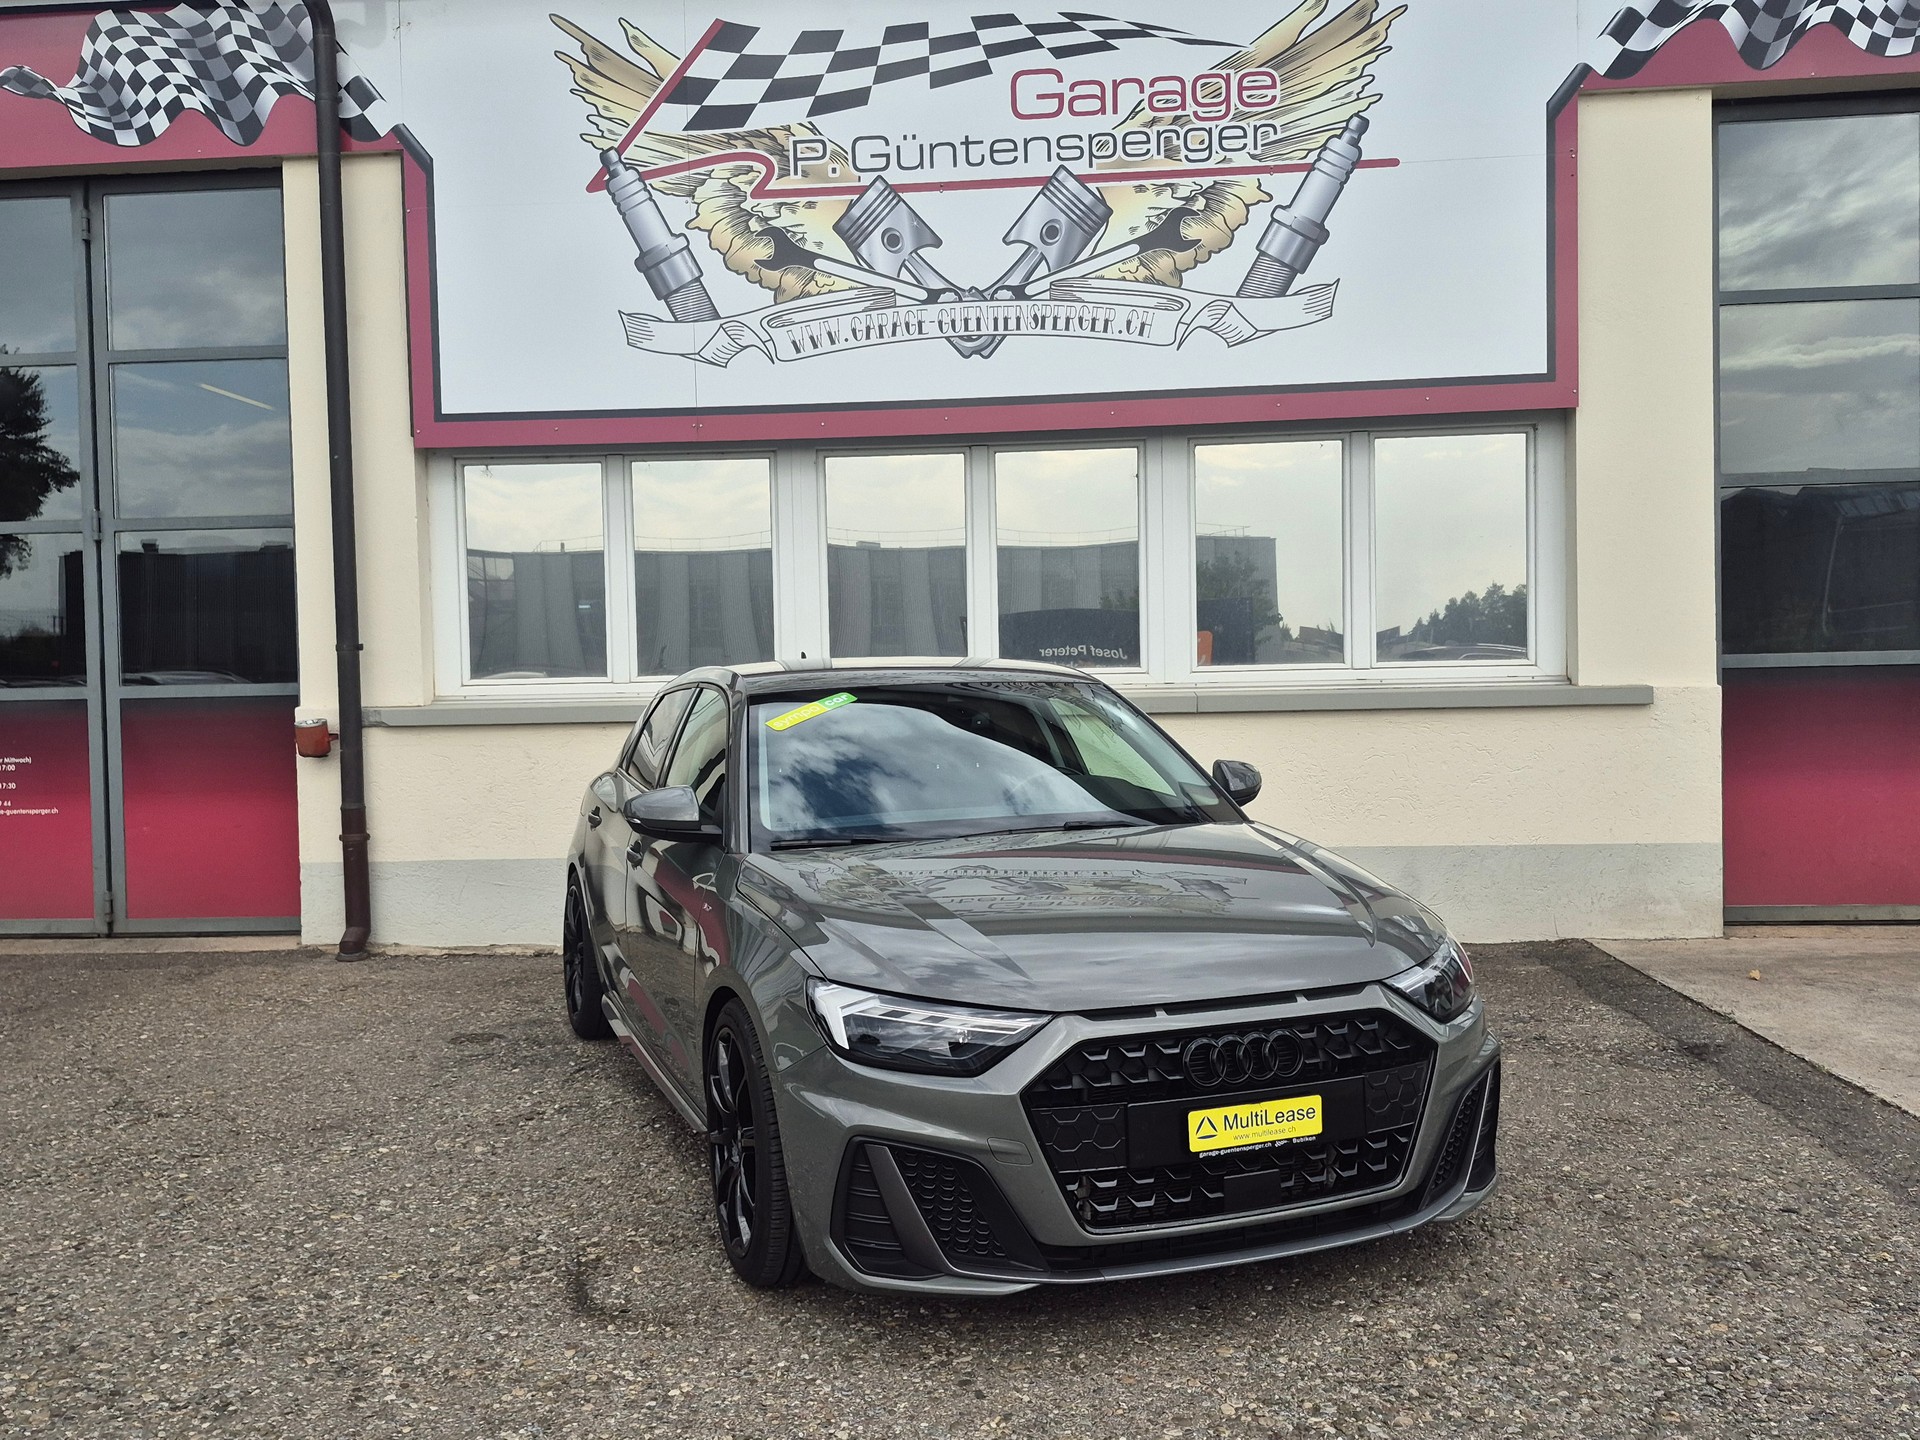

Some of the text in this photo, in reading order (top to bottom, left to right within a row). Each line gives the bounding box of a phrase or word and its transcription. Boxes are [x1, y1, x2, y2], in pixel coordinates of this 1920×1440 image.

[1010, 67, 1278, 122] Garage
[792, 122, 1278, 176] P. Güntensperger
[786, 304, 1155, 355] WWW.GARAGE-GUENTENSPERGER.CH
[1223, 1106, 1316, 1132] MultiLease
[1232, 1126, 1297, 1141] www.multilease.ch
